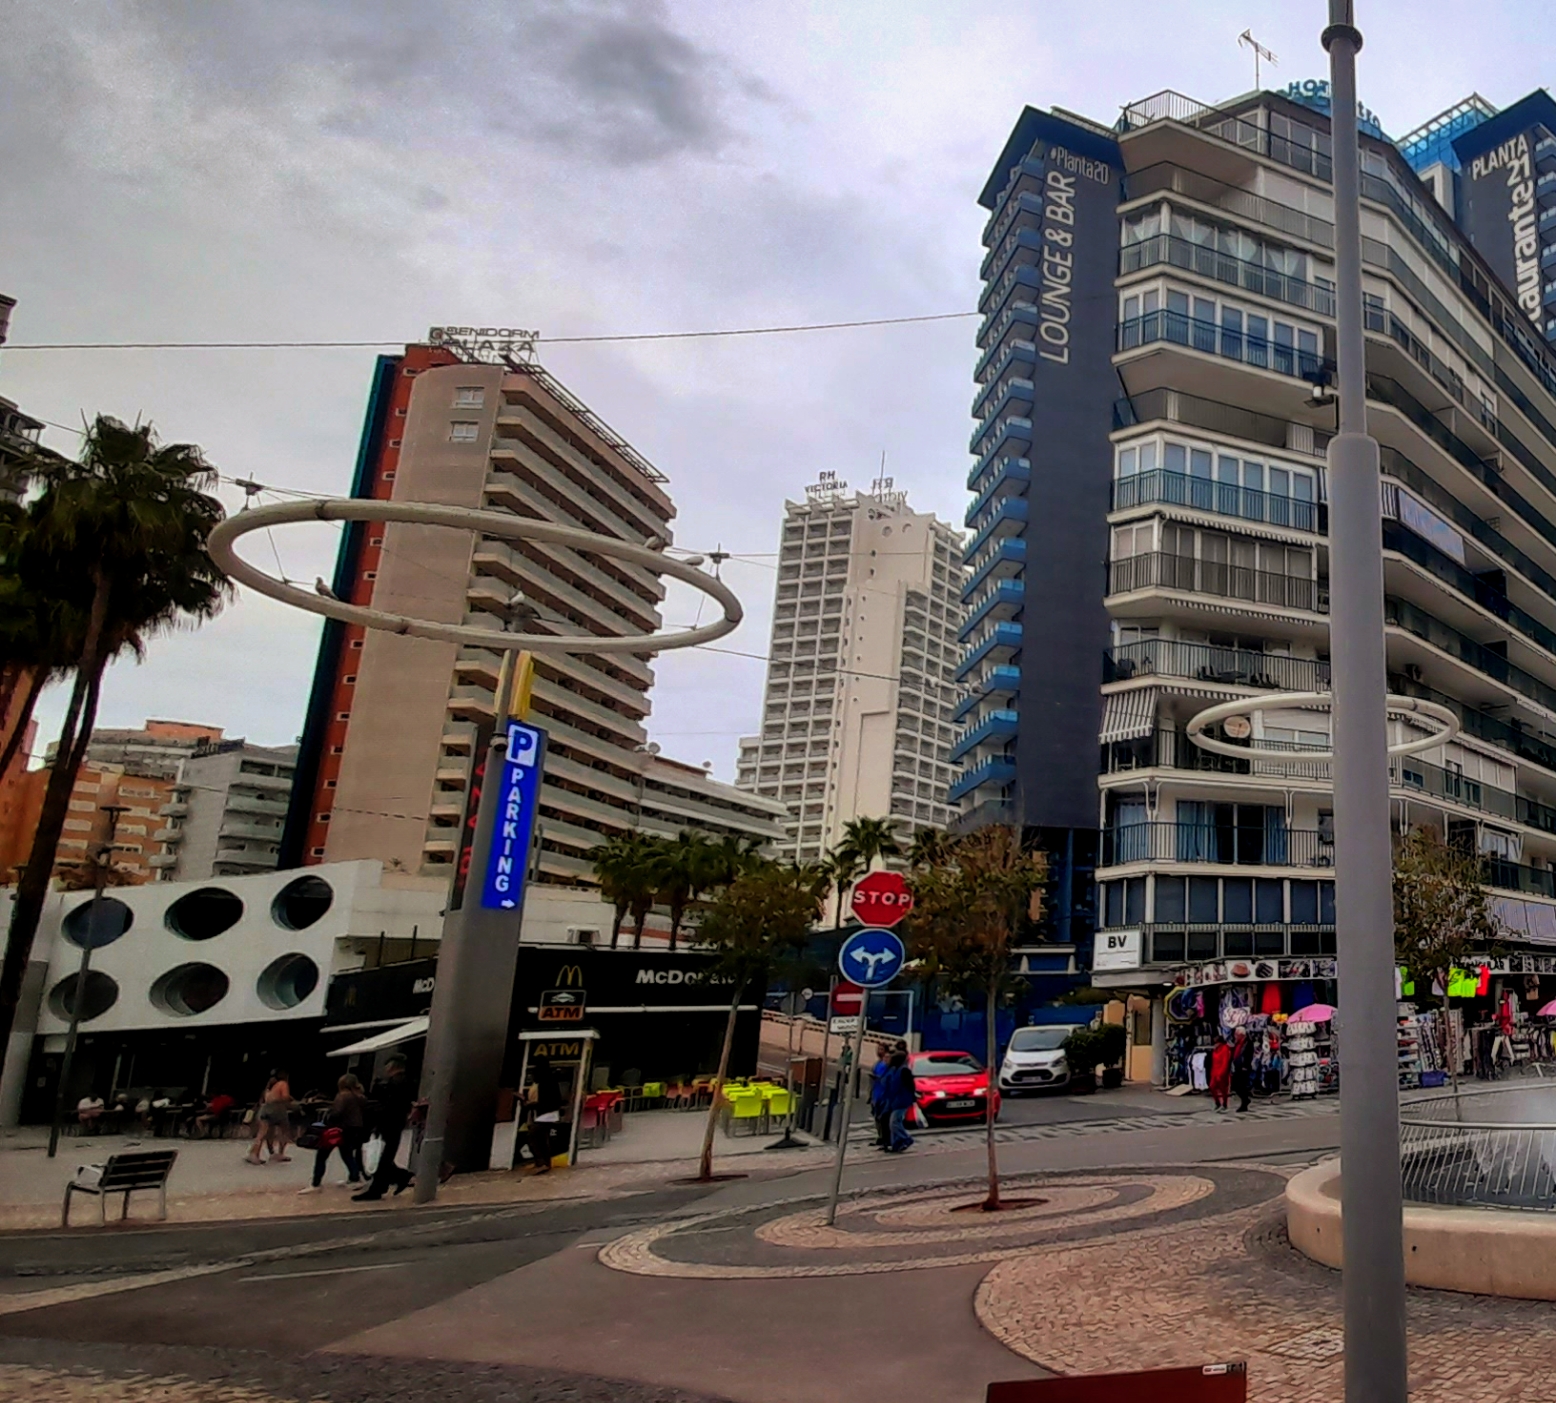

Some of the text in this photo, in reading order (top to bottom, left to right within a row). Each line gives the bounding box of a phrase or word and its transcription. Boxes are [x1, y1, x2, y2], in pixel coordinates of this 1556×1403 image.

[1472, 133, 1528, 181] PLANTA
[1507, 152, 1530, 187] 21
[1040, 171, 1076, 364] LOUNGE & BAR
[446, 326, 540, 339] BENIDORM
[820, 470, 836, 481] RH
[804, 480, 848, 493] VICTORIA
[510, 729, 534, 760] P
[495, 767, 525, 893] PARKING
[854, 890, 910, 907] STOP
[1108, 935, 1127, 949] BV
[541, 1007, 581, 1019] ATM
[533, 1042, 580, 1057] ATM
